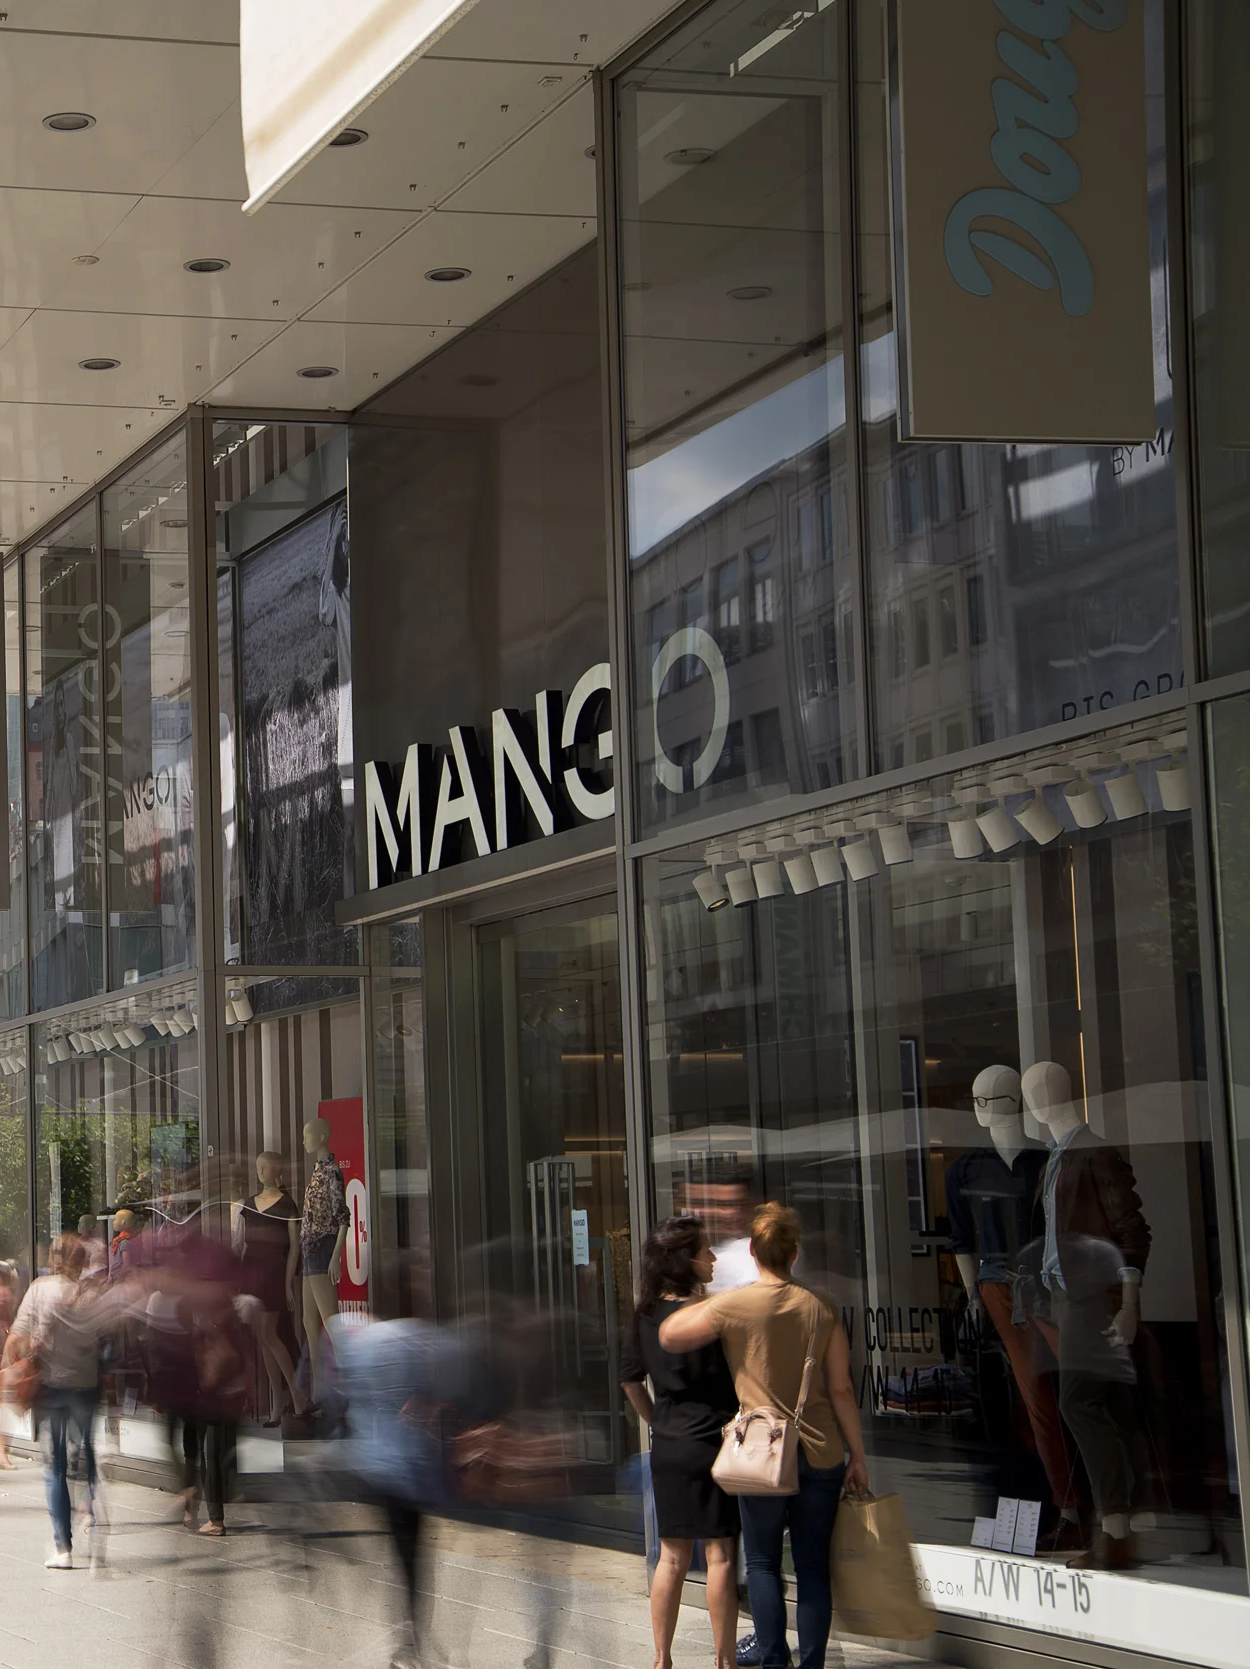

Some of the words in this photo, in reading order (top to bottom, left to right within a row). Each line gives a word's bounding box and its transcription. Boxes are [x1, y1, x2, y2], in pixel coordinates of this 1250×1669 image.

[1112, 446, 1135, 476] BY
[364, 626, 731, 891] MANGO
[864, 1306, 982, 1355] COLLECTION
[916, 1577, 964, 1597] GO.COM
[973, 1558, 1020, 1603] A/W
[1033, 1567, 1092, 1614] 14-15
